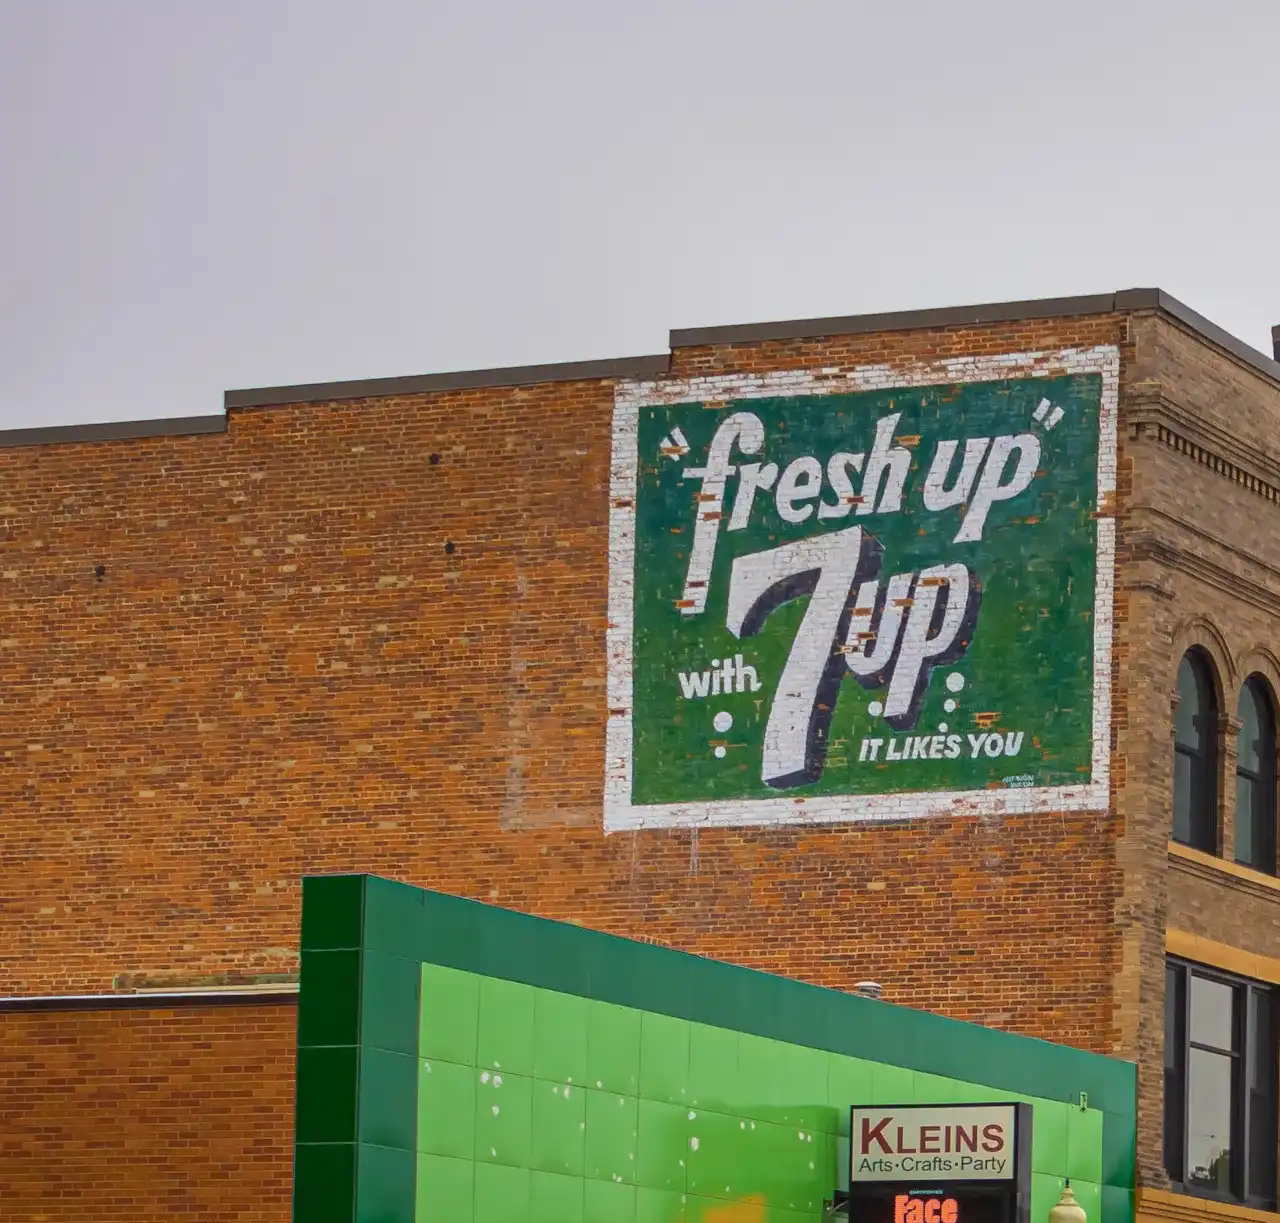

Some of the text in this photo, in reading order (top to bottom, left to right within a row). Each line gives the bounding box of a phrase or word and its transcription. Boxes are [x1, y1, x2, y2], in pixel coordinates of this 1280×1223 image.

[678, 653, 763, 699] with
[858, 731, 1025, 762] IT LIKES YOU
[861, 1116, 1005, 1155] KLEINS
[960, 1155, 1007, 1174] Party
